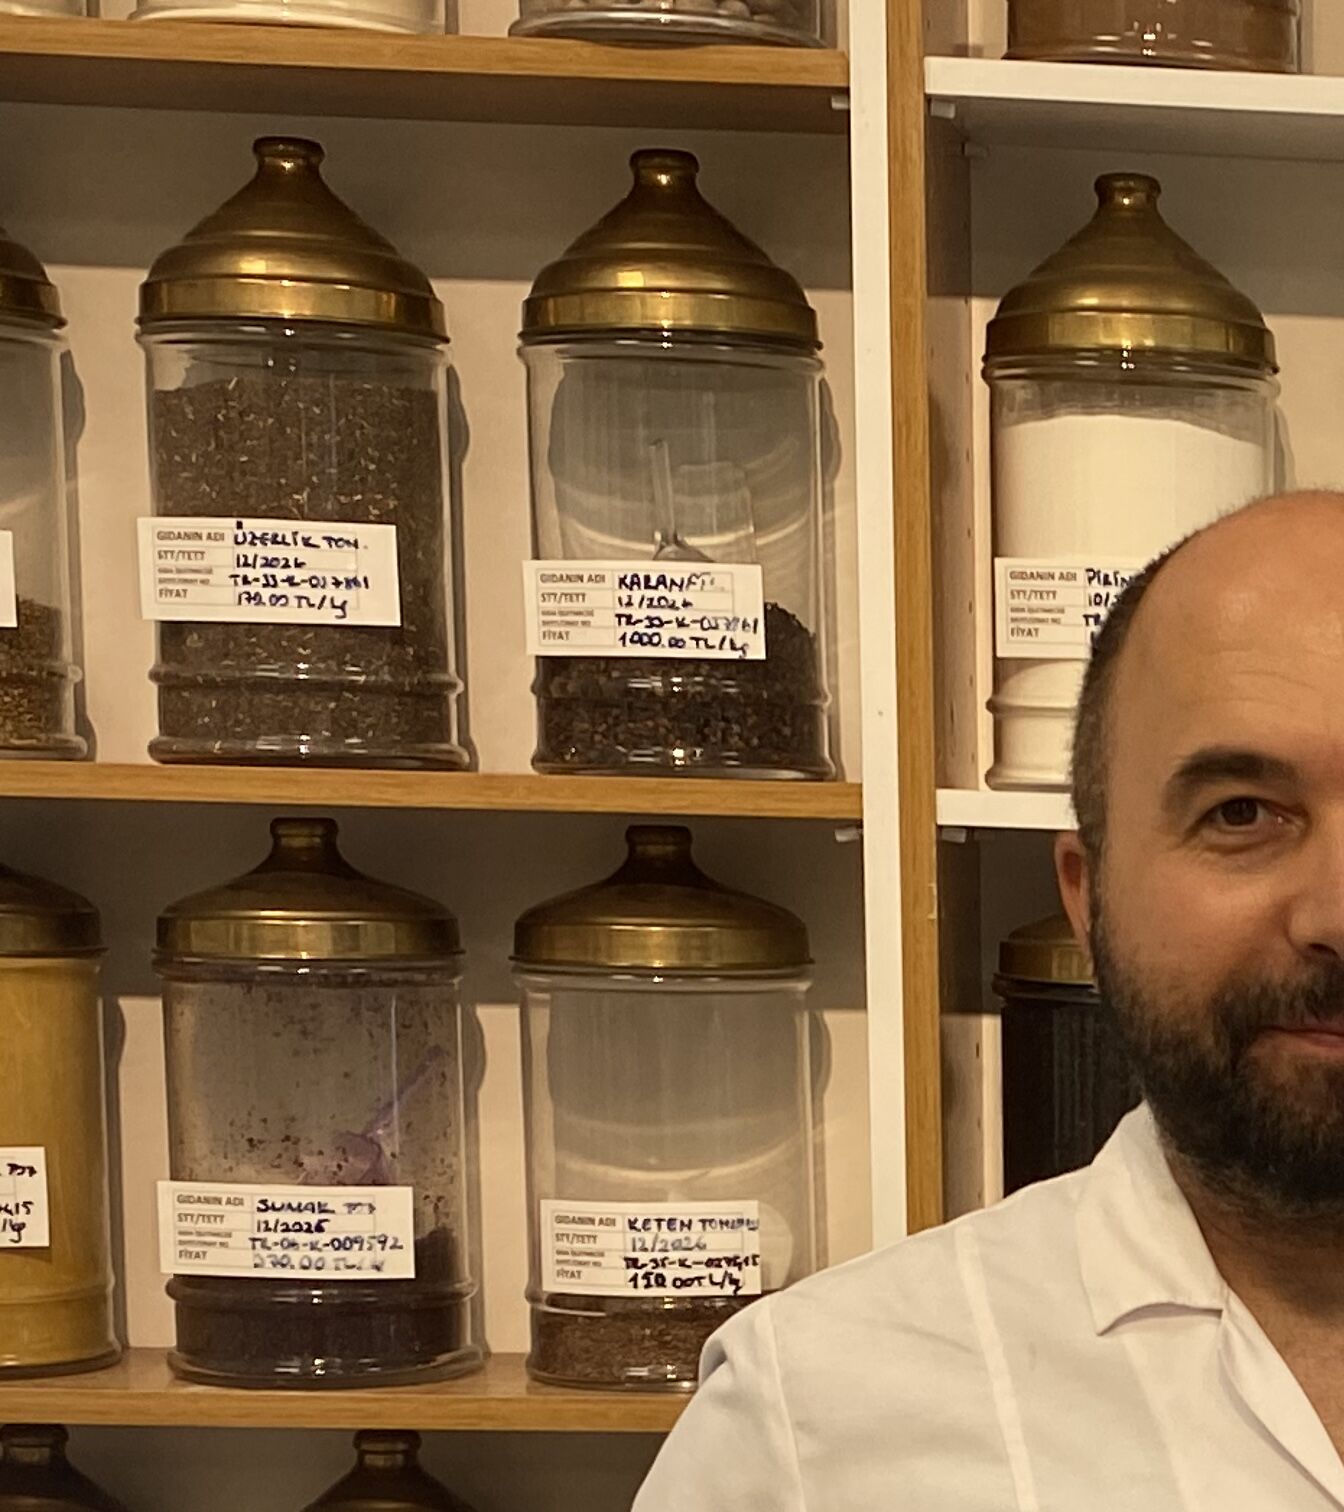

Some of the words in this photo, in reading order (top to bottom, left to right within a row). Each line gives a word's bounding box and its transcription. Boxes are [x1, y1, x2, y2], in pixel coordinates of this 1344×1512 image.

[157, 531, 204, 541] GIDANIN
[206, 531, 225, 542] ADI
[540, 574, 584, 583] GIDANIN
[587, 574, 606, 583] ADI
[1009, 571, 1056, 581] GIDANIN
[1058, 571, 1077, 581] ADI
